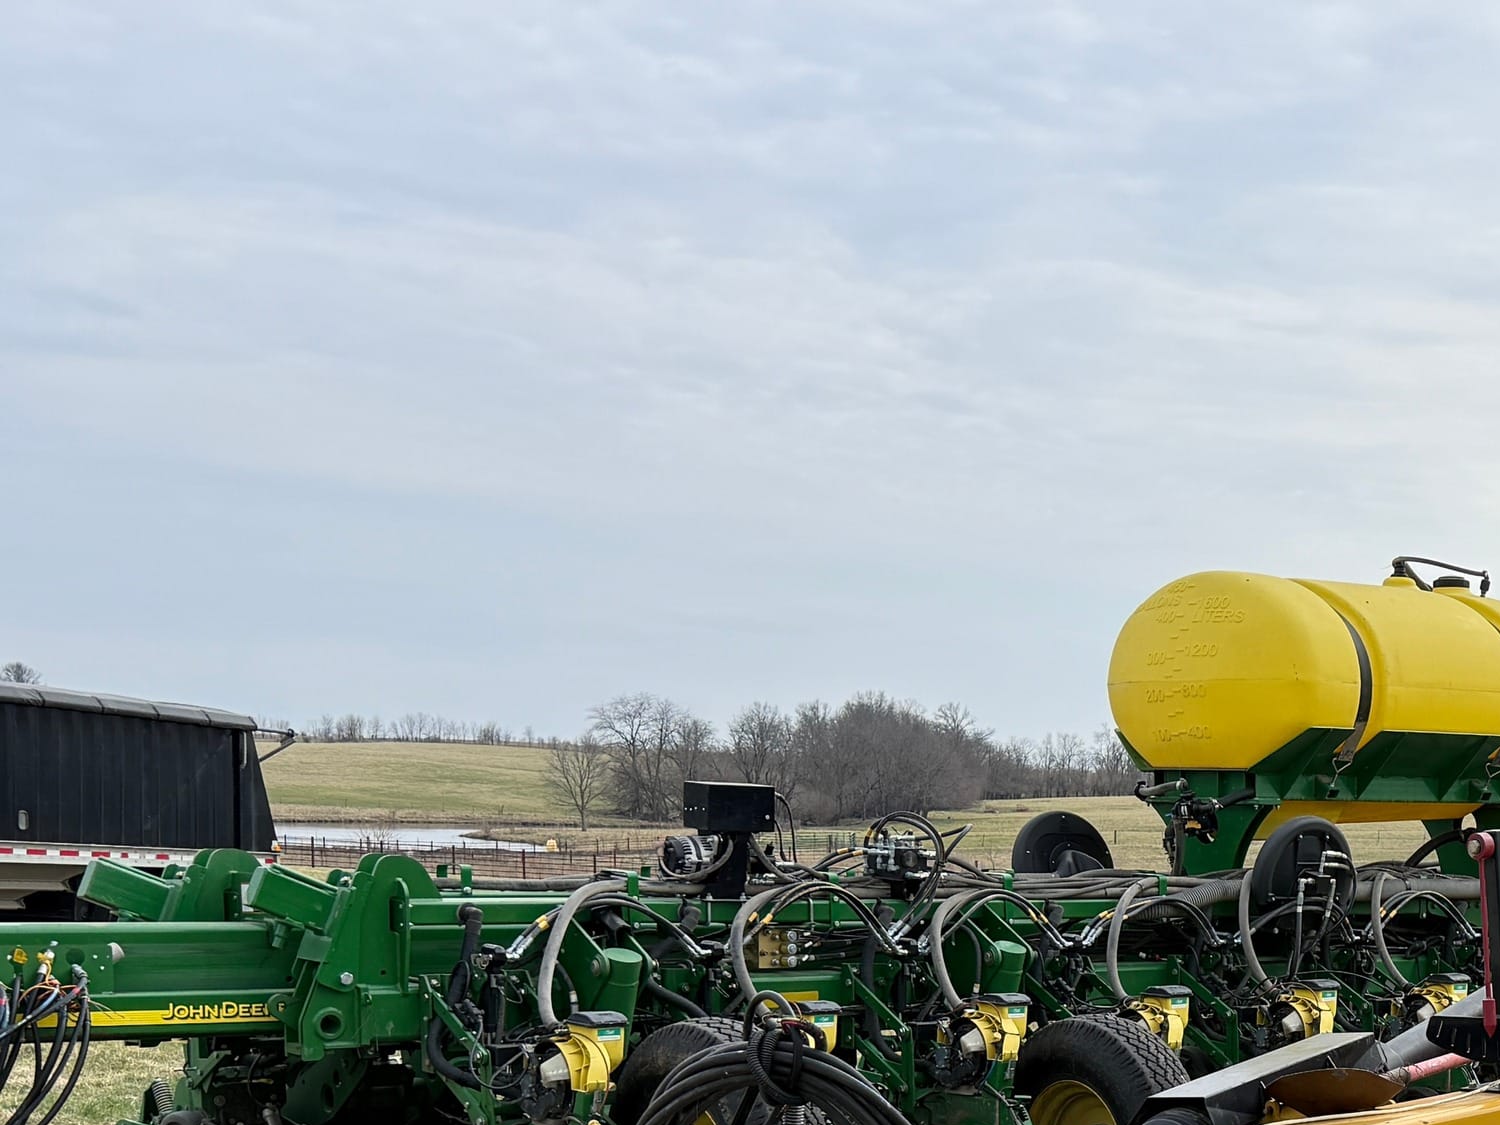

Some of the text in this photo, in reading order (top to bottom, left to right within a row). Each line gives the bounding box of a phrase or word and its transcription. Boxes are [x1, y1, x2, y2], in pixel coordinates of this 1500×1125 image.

[1192, 610, 1246, 624] LITERS
[1184, 643, 1218, 657] 1200
[1146, 689, 1166, 703] 200
[162, 1001, 219, 1020] JOHN
